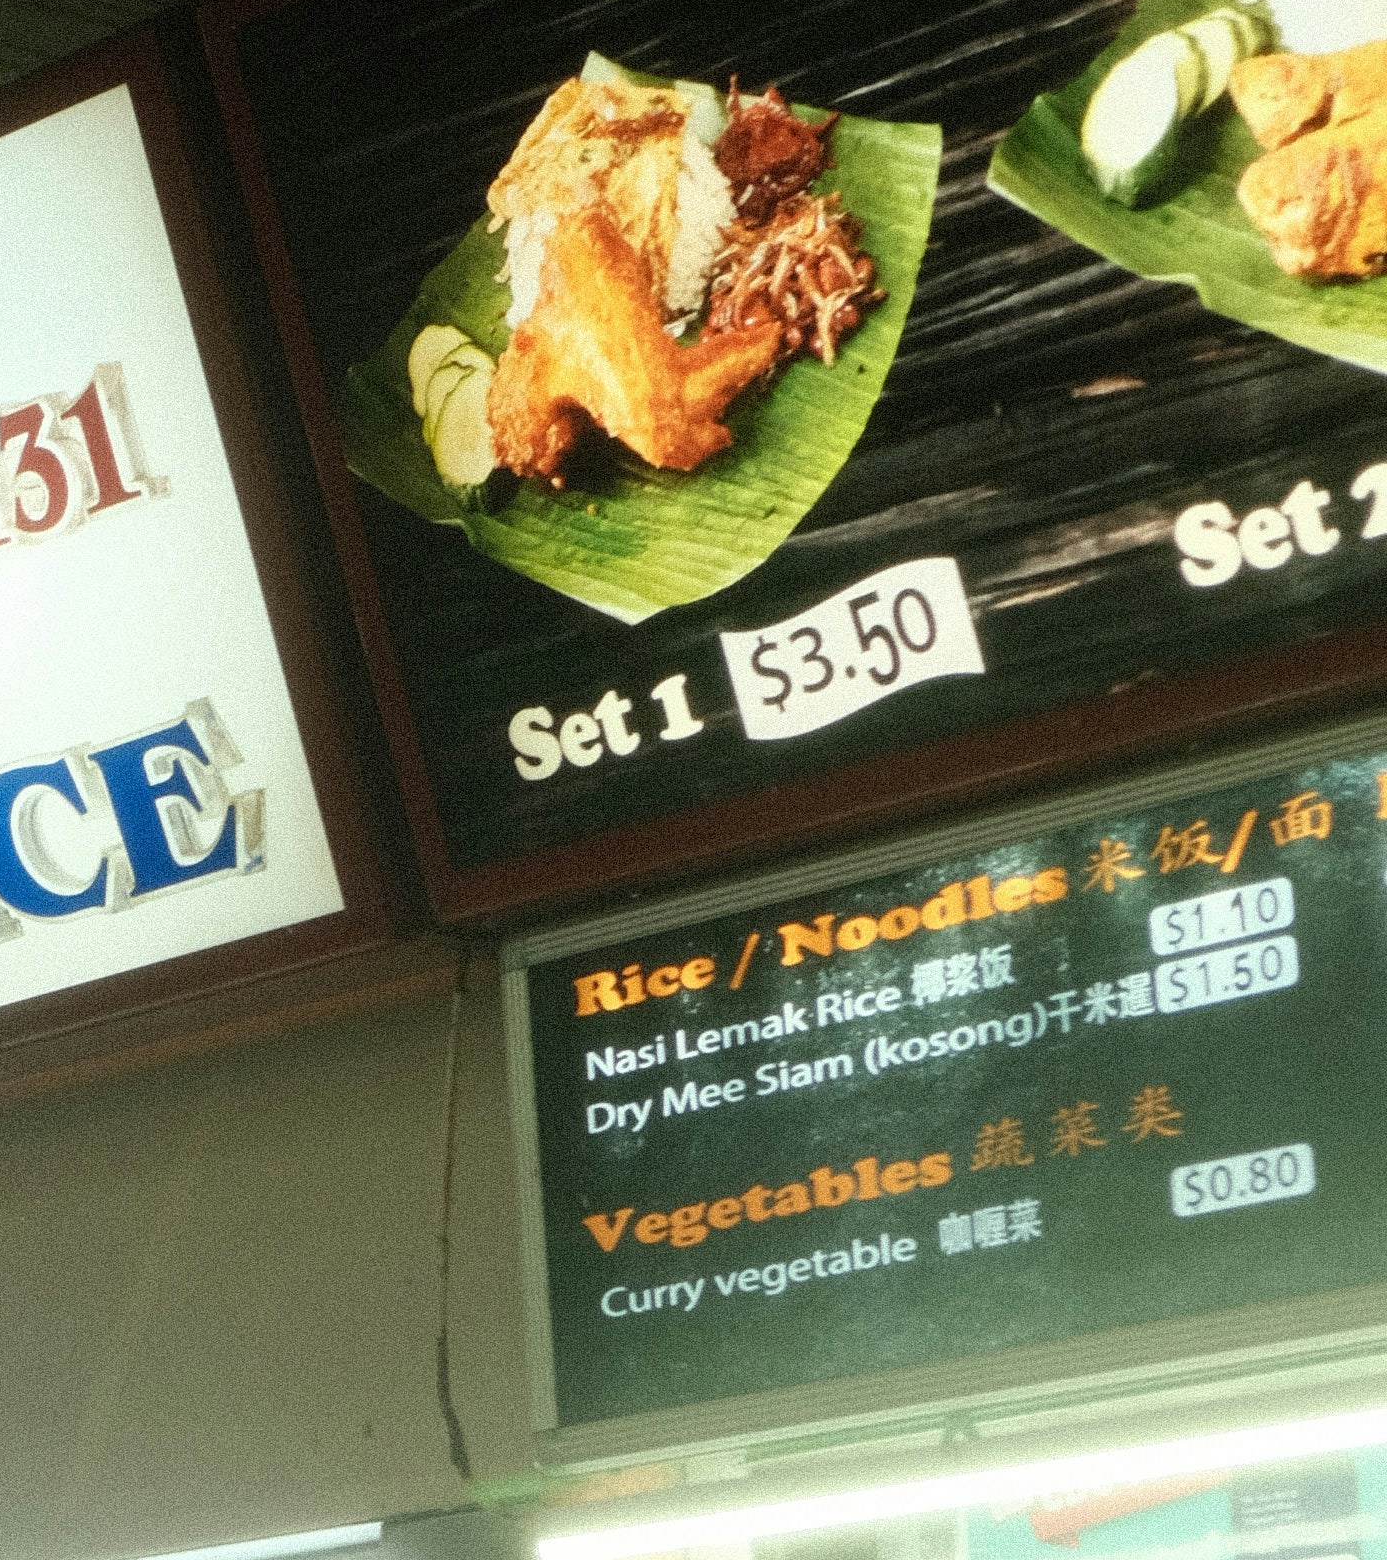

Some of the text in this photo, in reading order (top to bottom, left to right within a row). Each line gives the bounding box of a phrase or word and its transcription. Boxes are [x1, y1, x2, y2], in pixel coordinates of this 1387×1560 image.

[1175, 479, 1342, 588] Set
[746, 584, 941, 712] $3.50
[508, 672, 705, 781] Set 1
[575, 954, 715, 1017] Rice
[780, 866, 1068, 968] Noodles
[1164, 884, 1282, 950] $1.10
[1166, 944, 1286, 1007] $1.50
[585, 1035, 665, 1082] Nasi
[675, 999, 808, 1060] Lemak
[817, 981, 902, 1027] Rice
[586, 1097, 652, 1135] Dry
[662, 1076, 746, 1121] Mee
[754, 1051, 853, 1099] Siam
[584, 1149, 955, 1255] Vegetables
[1184, 1148, 1302, 1210] $0.80
[601, 1272, 704, 1319] Curry
[714, 1232, 919, 1296] vegetable
